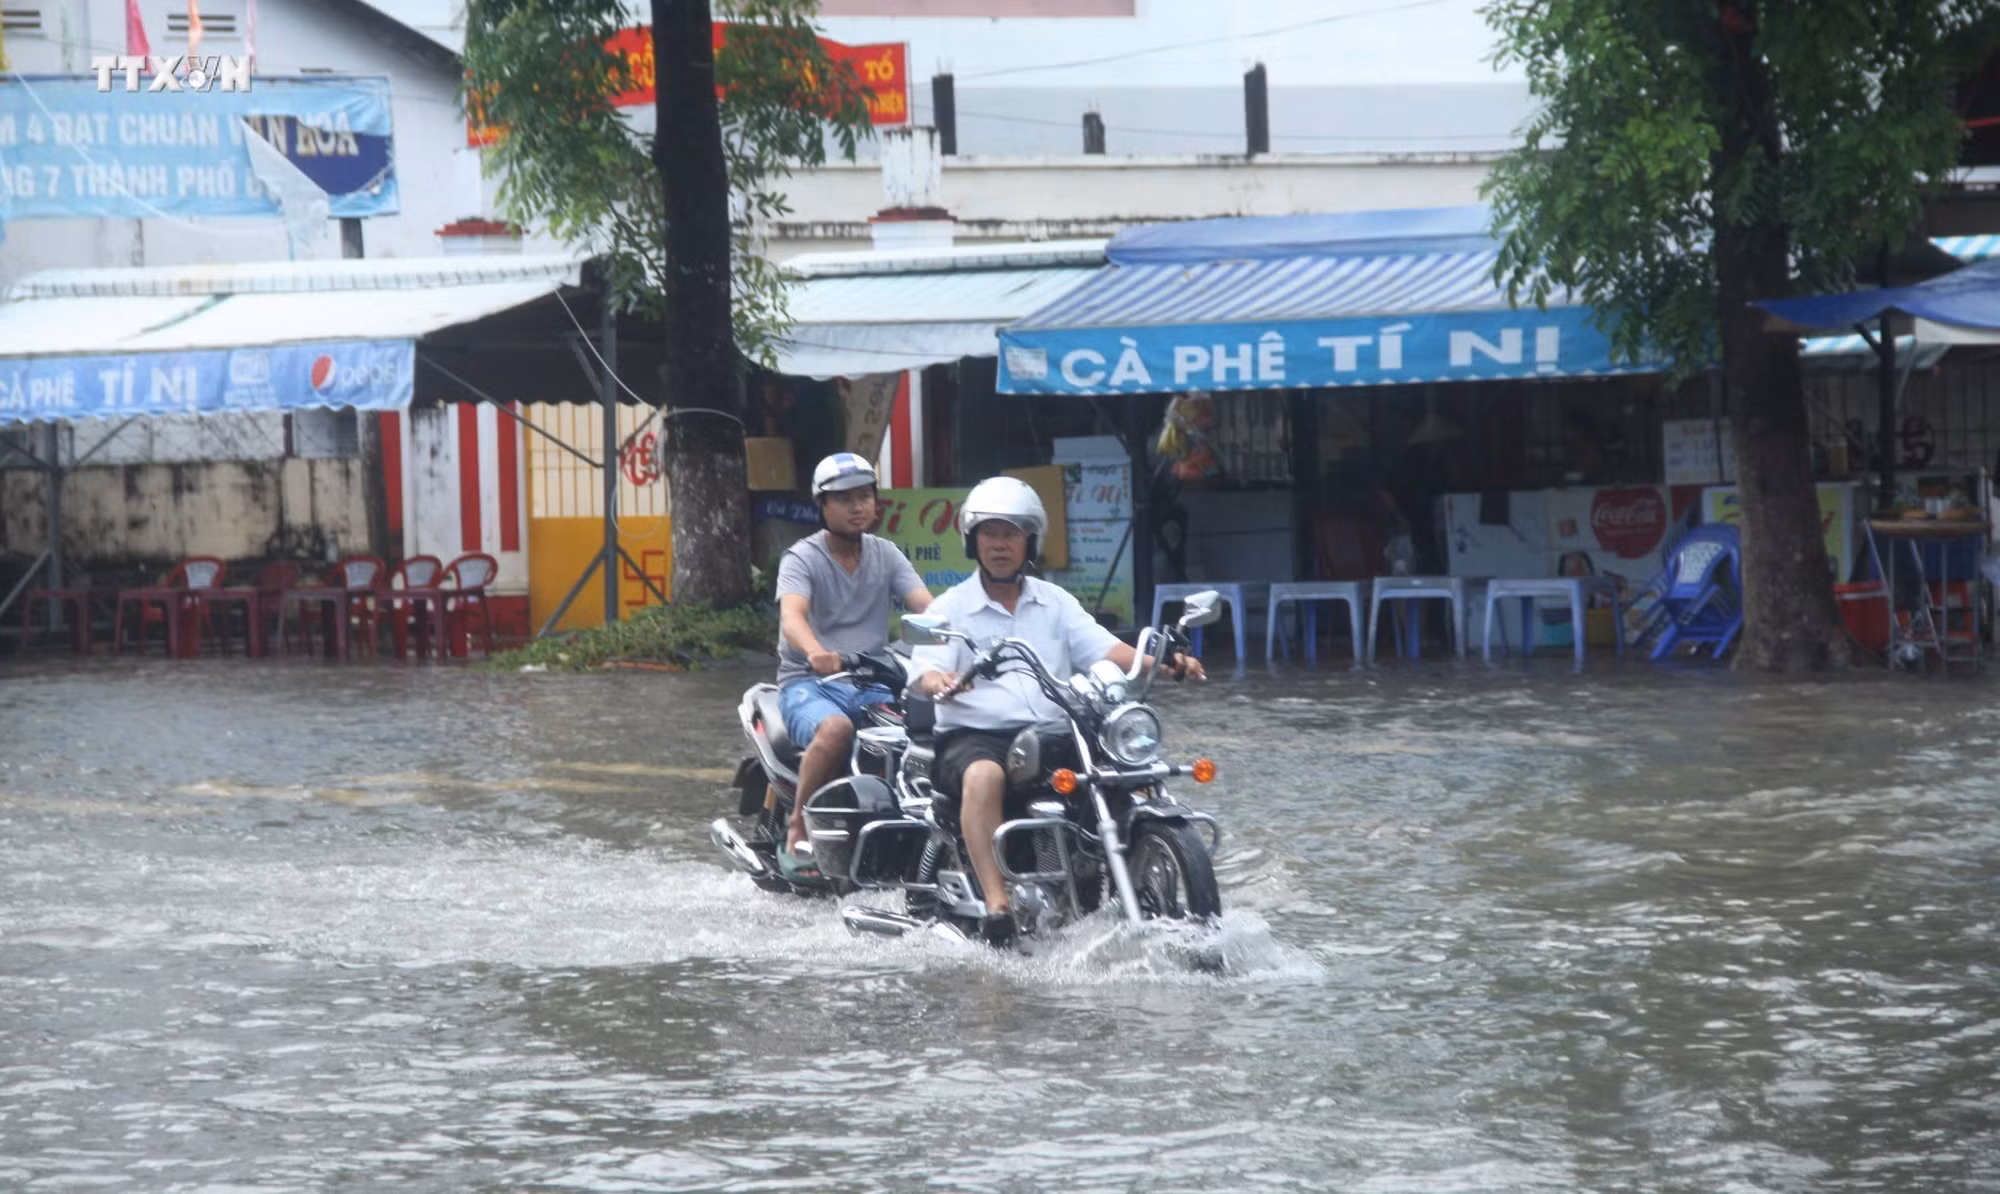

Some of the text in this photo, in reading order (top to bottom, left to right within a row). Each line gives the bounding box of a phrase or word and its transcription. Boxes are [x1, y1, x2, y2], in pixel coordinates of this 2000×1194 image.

[26, 113, 45, 146] 4
[52, 112, 110, 152] ĐẠT
[42, 164, 62, 198] 7
[70, 158, 168, 198] THÀNH
[176, 157, 238, 199] PHỐ
[1060, 336, 1152, 386] CÀ
[1173, 331, 1287, 384] PHÊ
[1316, 322, 1413, 374] TÍ
[1449, 326, 1561, 374] NỊ
[30, 367, 75, 408] PHÊ
[99, 357, 136, 405] TÍ
[149, 365, 198, 411] NỊ
